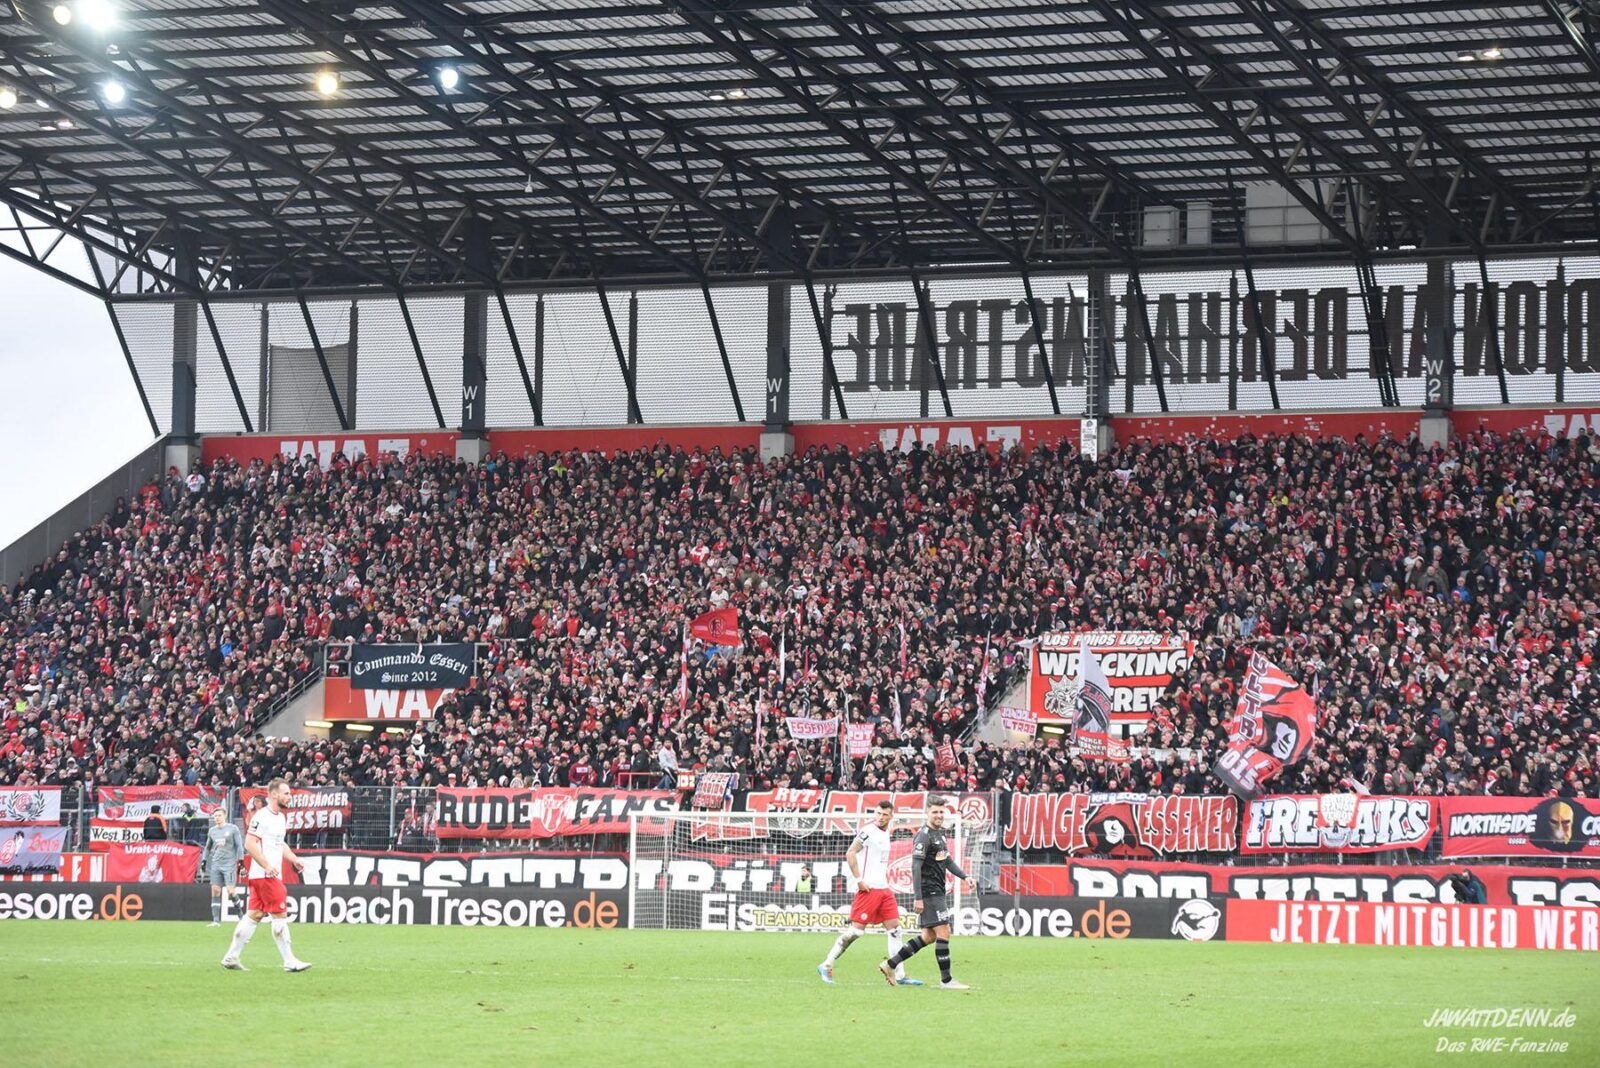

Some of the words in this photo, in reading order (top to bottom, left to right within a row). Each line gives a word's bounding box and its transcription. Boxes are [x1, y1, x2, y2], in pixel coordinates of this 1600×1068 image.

[1426, 359, 1444, 375] W
[1428, 378, 1441, 397] 2
[1045, 634, 1070, 647] LOS
[354, 653, 425, 676] Commando
[429, 653, 469, 675] Essen
[1039, 651, 1187, 678] WRCKING
[381, 671, 409, 683] Since
[411, 671, 437, 682] 2012
[288, 791, 349, 809] AFENSÄNGER
[286, 809, 343, 830] ESSEN
[438, 793, 531, 830] RUDE
[1003, 792, 1091, 851] JUNGE
[92, 827, 118, 841] West
[1138, 794, 1239, 853] ESSENER
[1450, 814, 1537, 837] NORTHSIDE
[125, 844, 184, 857] Uralt-Ultras
[422, 889, 620, 929] Tresore.de
[1270, 903, 1360, 944] JETZT
[1375, 905, 1517, 948] MITGLIED
